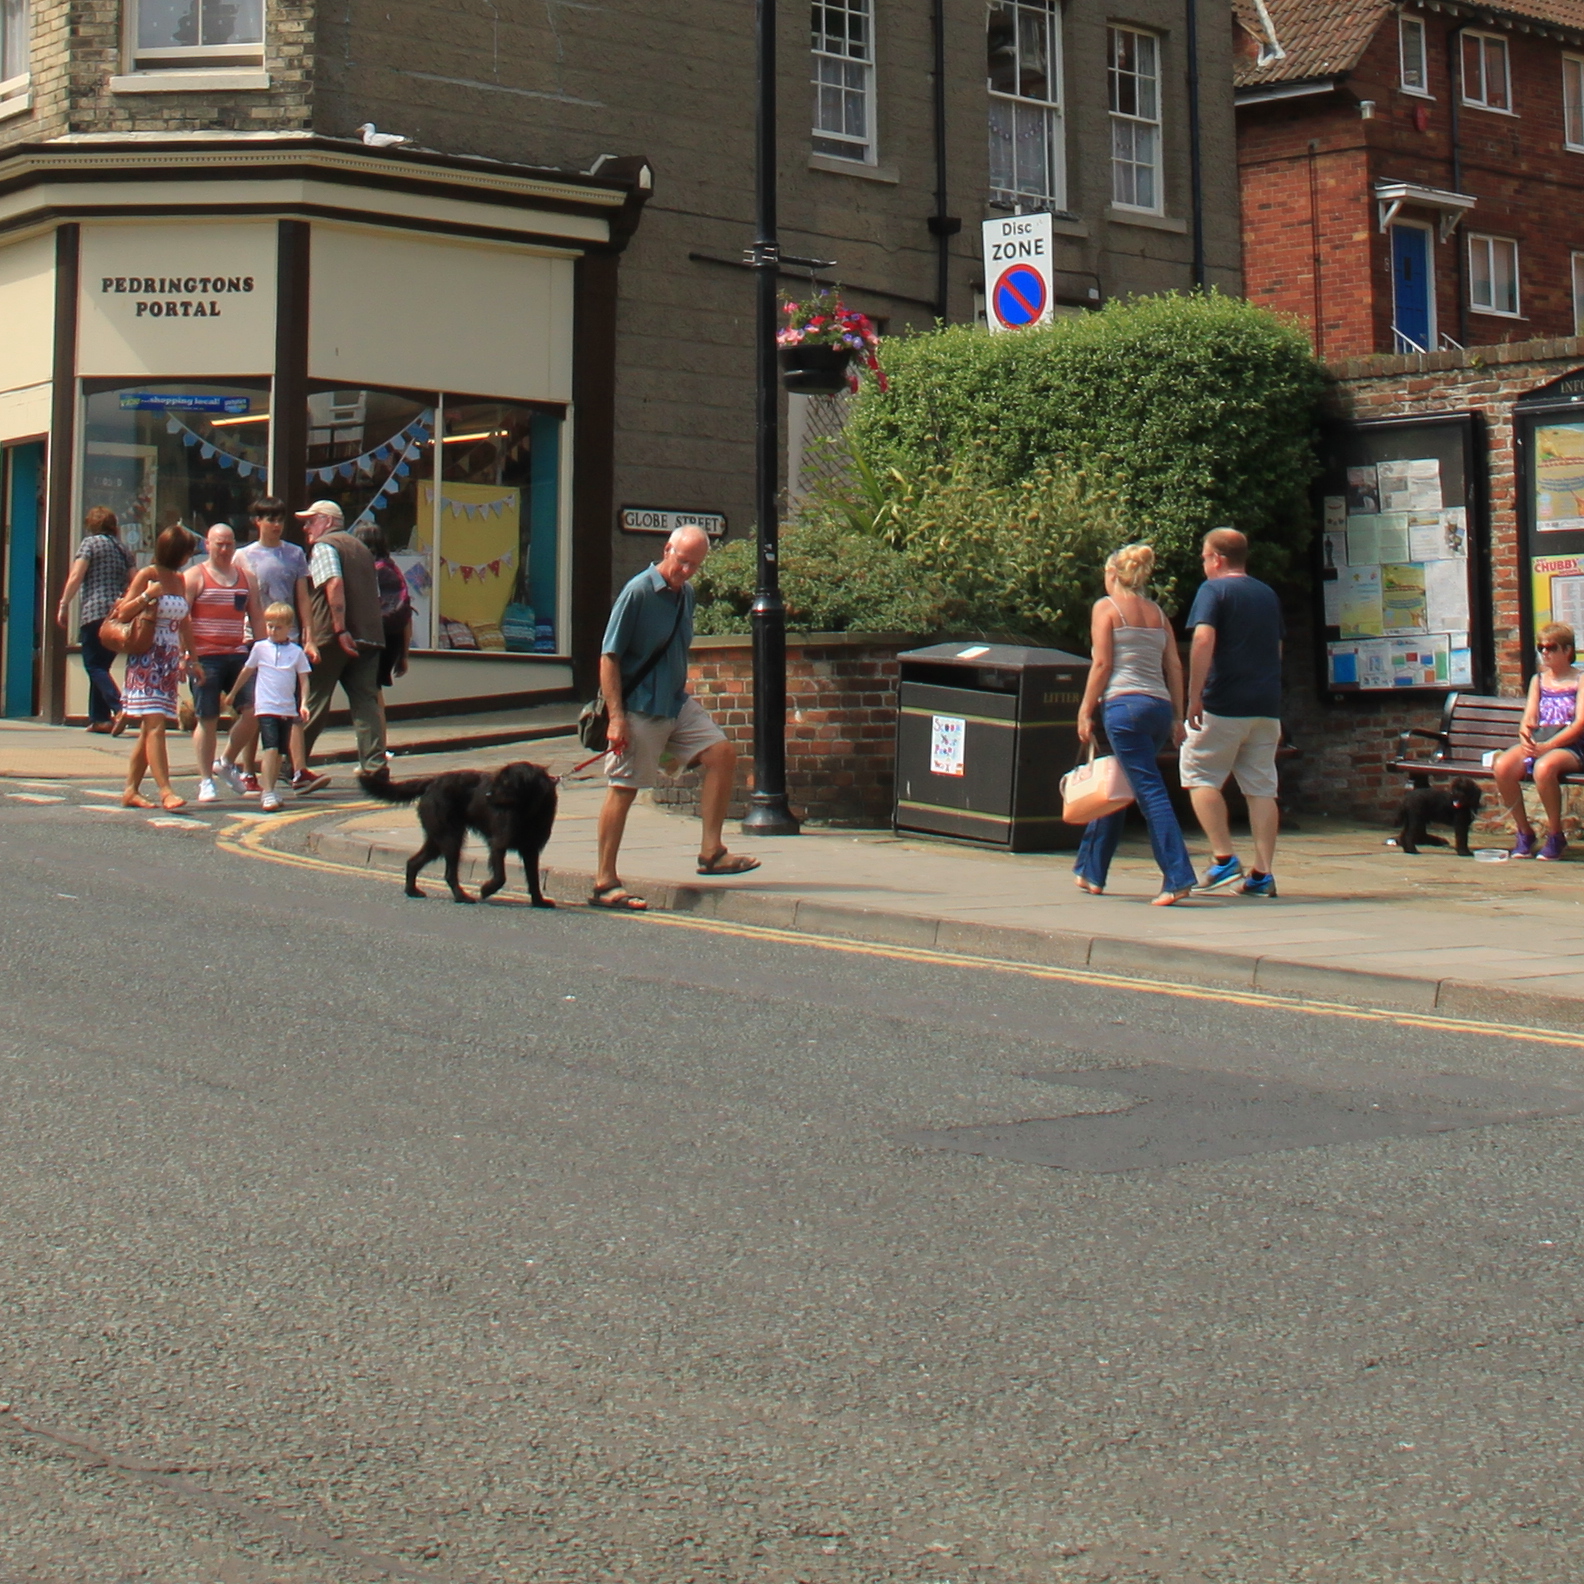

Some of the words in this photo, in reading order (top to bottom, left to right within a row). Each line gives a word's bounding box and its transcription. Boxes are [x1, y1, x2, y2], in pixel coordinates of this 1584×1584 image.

[1002, 222, 1032, 236] Disc
[992, 238, 1044, 261] ZONE
[102, 277, 254, 293] PEDRINGTONS
[136, 301, 221, 317] PORTAL
[625, 512, 668, 528] GLOBE
[1534, 559, 1578, 573] CHUBBY
[1043, 692, 1079, 704] LITTER
